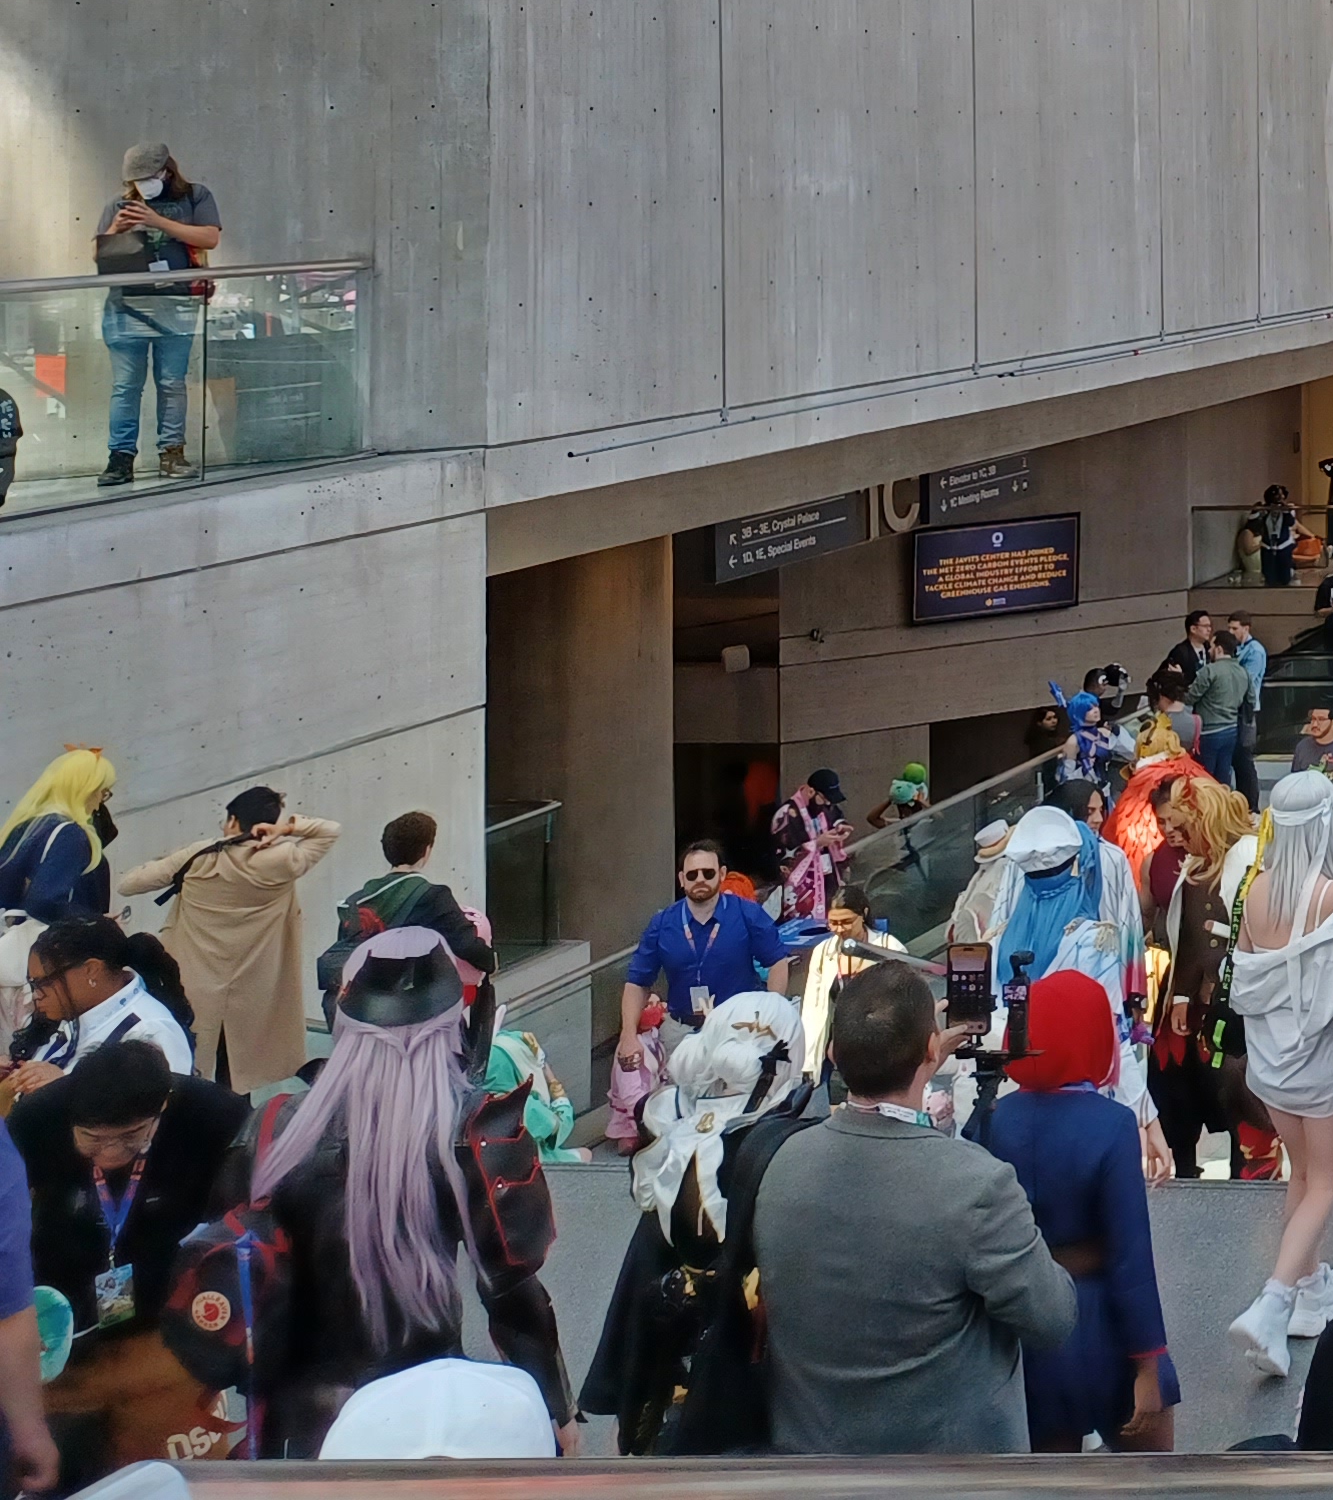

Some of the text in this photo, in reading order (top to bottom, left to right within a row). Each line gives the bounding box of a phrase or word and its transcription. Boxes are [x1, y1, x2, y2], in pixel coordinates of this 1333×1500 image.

[772, 515, 795, 532] Crystal
[797, 512, 819, 524] Palace
[768, 541, 792, 558] Special
[794, 536, 816, 549] Events
[939, 566, 955, 574] NET
[977, 560, 1008, 570] CARBON
[1010, 557, 1038, 567] EVENTS
[955, 555, 979, 564] JAVITS
[981, 552, 1009, 561] CENTER
[945, 573, 975, 581] GLOBAL
[976, 568, 1014, 578] INDUSTRY
[1015, 565, 1043, 573] EFFORT
[925, 583, 953, 592] TACKLE
[954, 580, 986, 589] CLIMATE
[987, 576, 1019, 585] CHANGE
